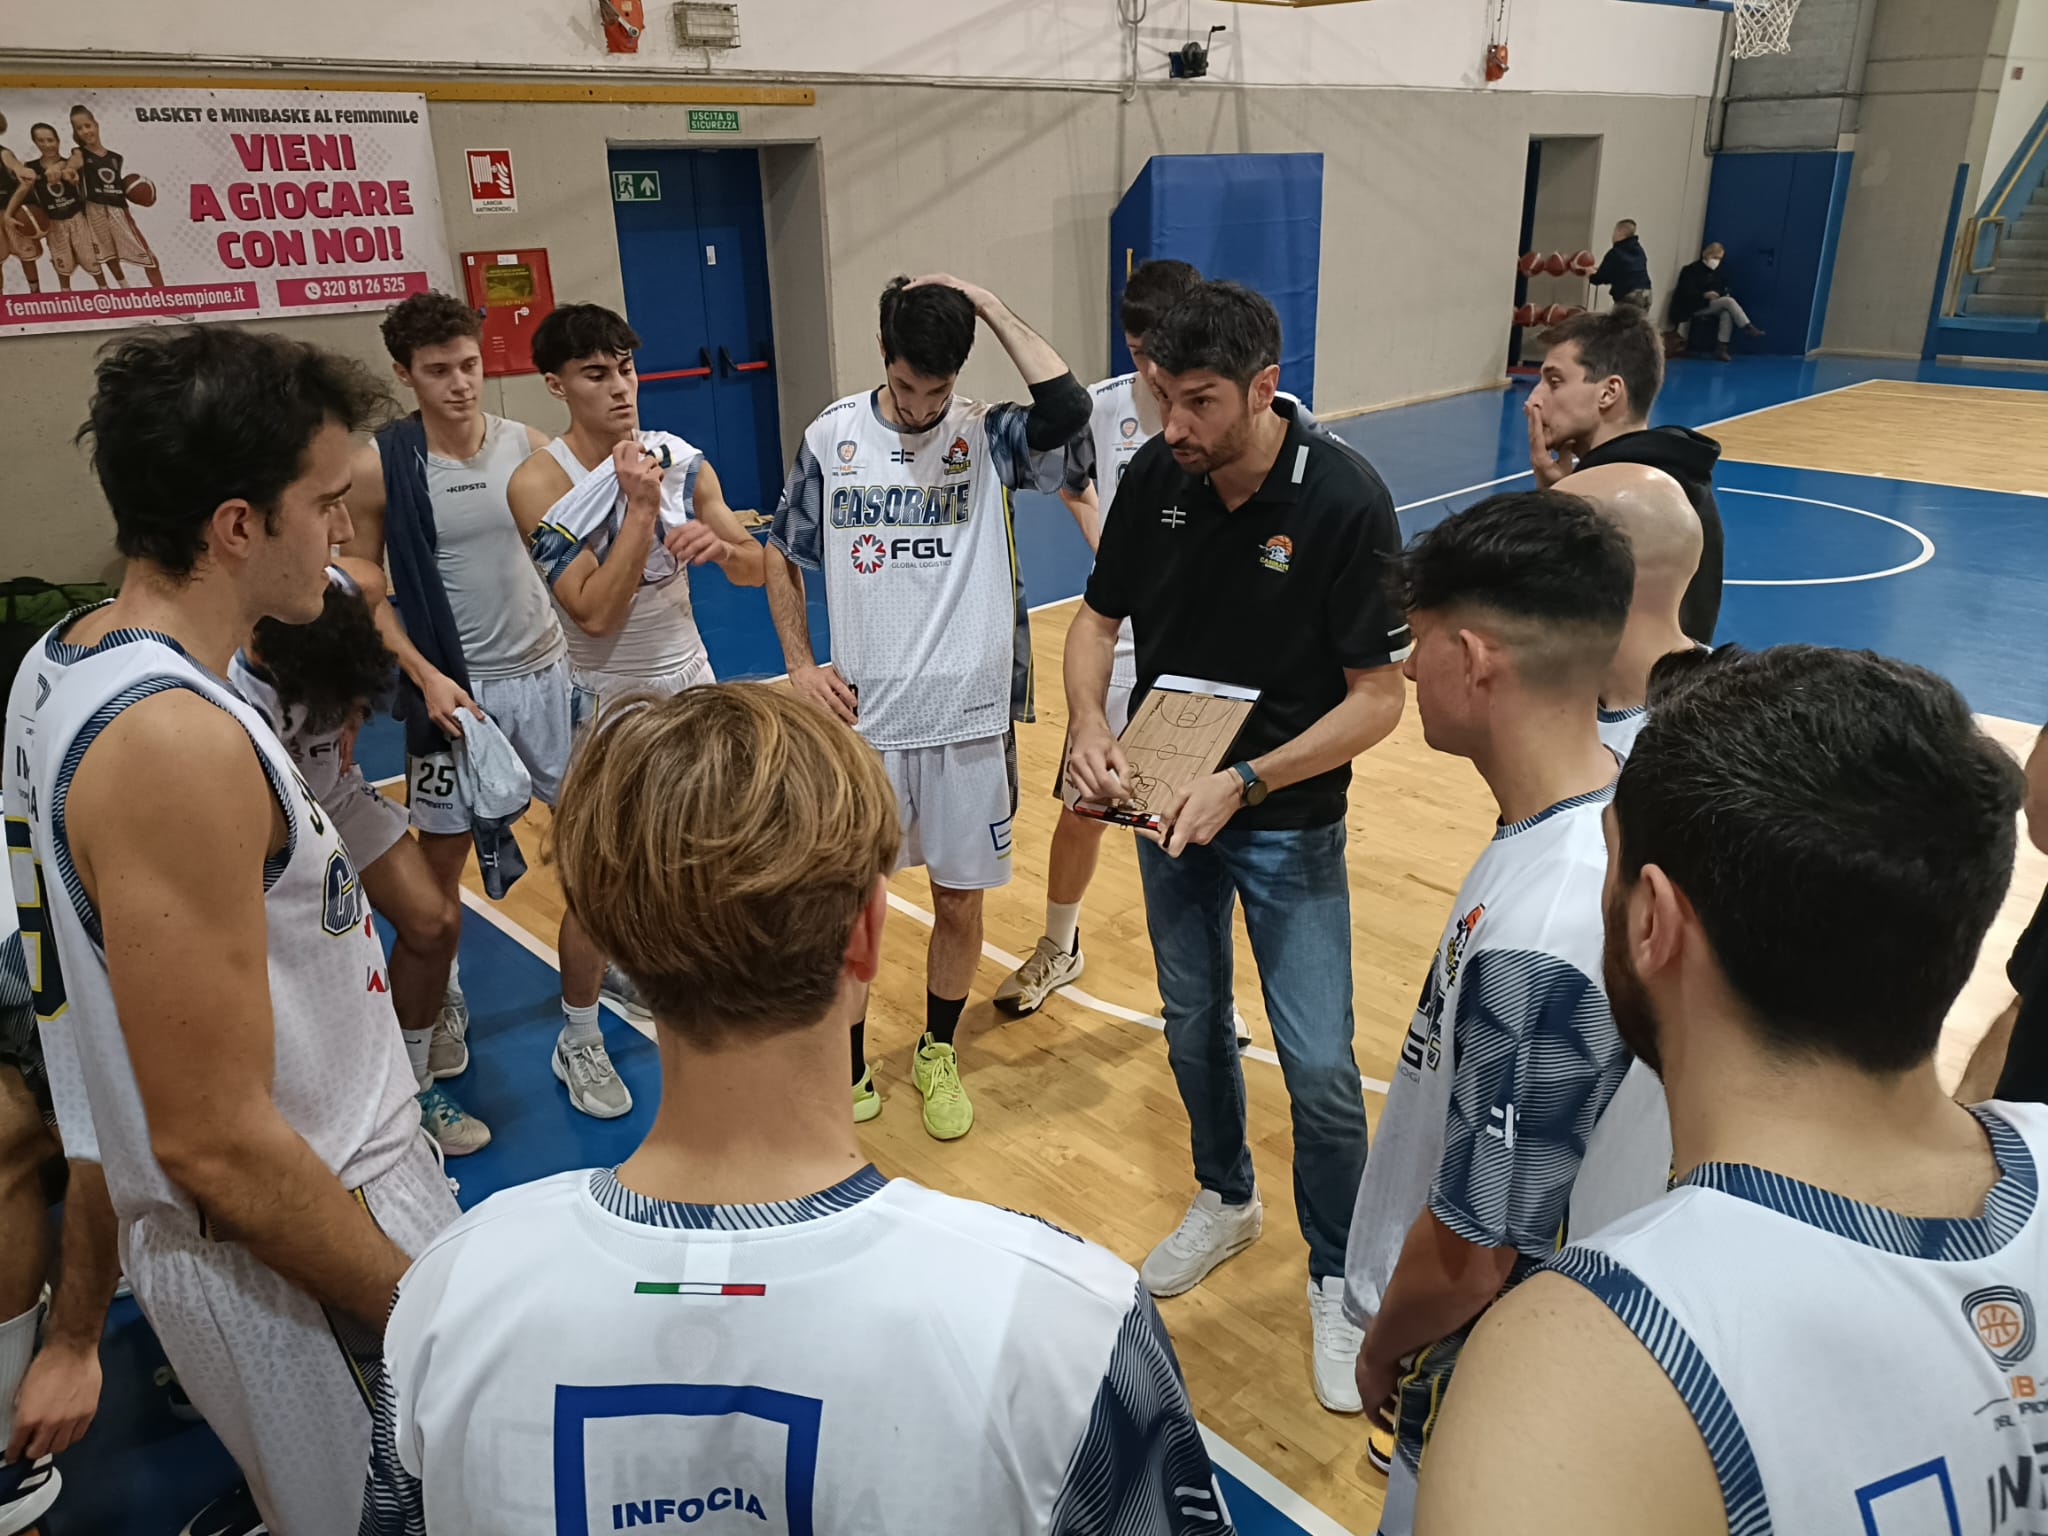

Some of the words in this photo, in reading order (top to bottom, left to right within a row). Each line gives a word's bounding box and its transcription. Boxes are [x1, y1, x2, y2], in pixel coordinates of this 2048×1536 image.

[135, 107, 202, 122] BASKET
[206, 107, 218, 122] e
[314, 109, 333, 123] AL
[691, 111, 724, 121] USCITA
[726, 112, 736, 121] DI
[691, 120, 738, 129] SICUREZZA
[230, 133, 357, 172] VIENI
[189, 183, 227, 222] A
[227, 180, 414, 221] GIOCARE
[216, 229, 308, 270] CON
[312, 226, 404, 265] NOI!
[5, 287, 246, 317] femminile@hubdelsempione.it
[321, 280, 347, 297] 320
[349, 279, 364, 295] 81
[365, 278, 381, 294] 26
[382, 276, 406, 293] 525
[829, 480, 971, 529] CASORATE
[890, 537, 953, 560] FGL
[417, 762, 457, 797] 25
[612, 1486, 768, 1530] INFOCIA
